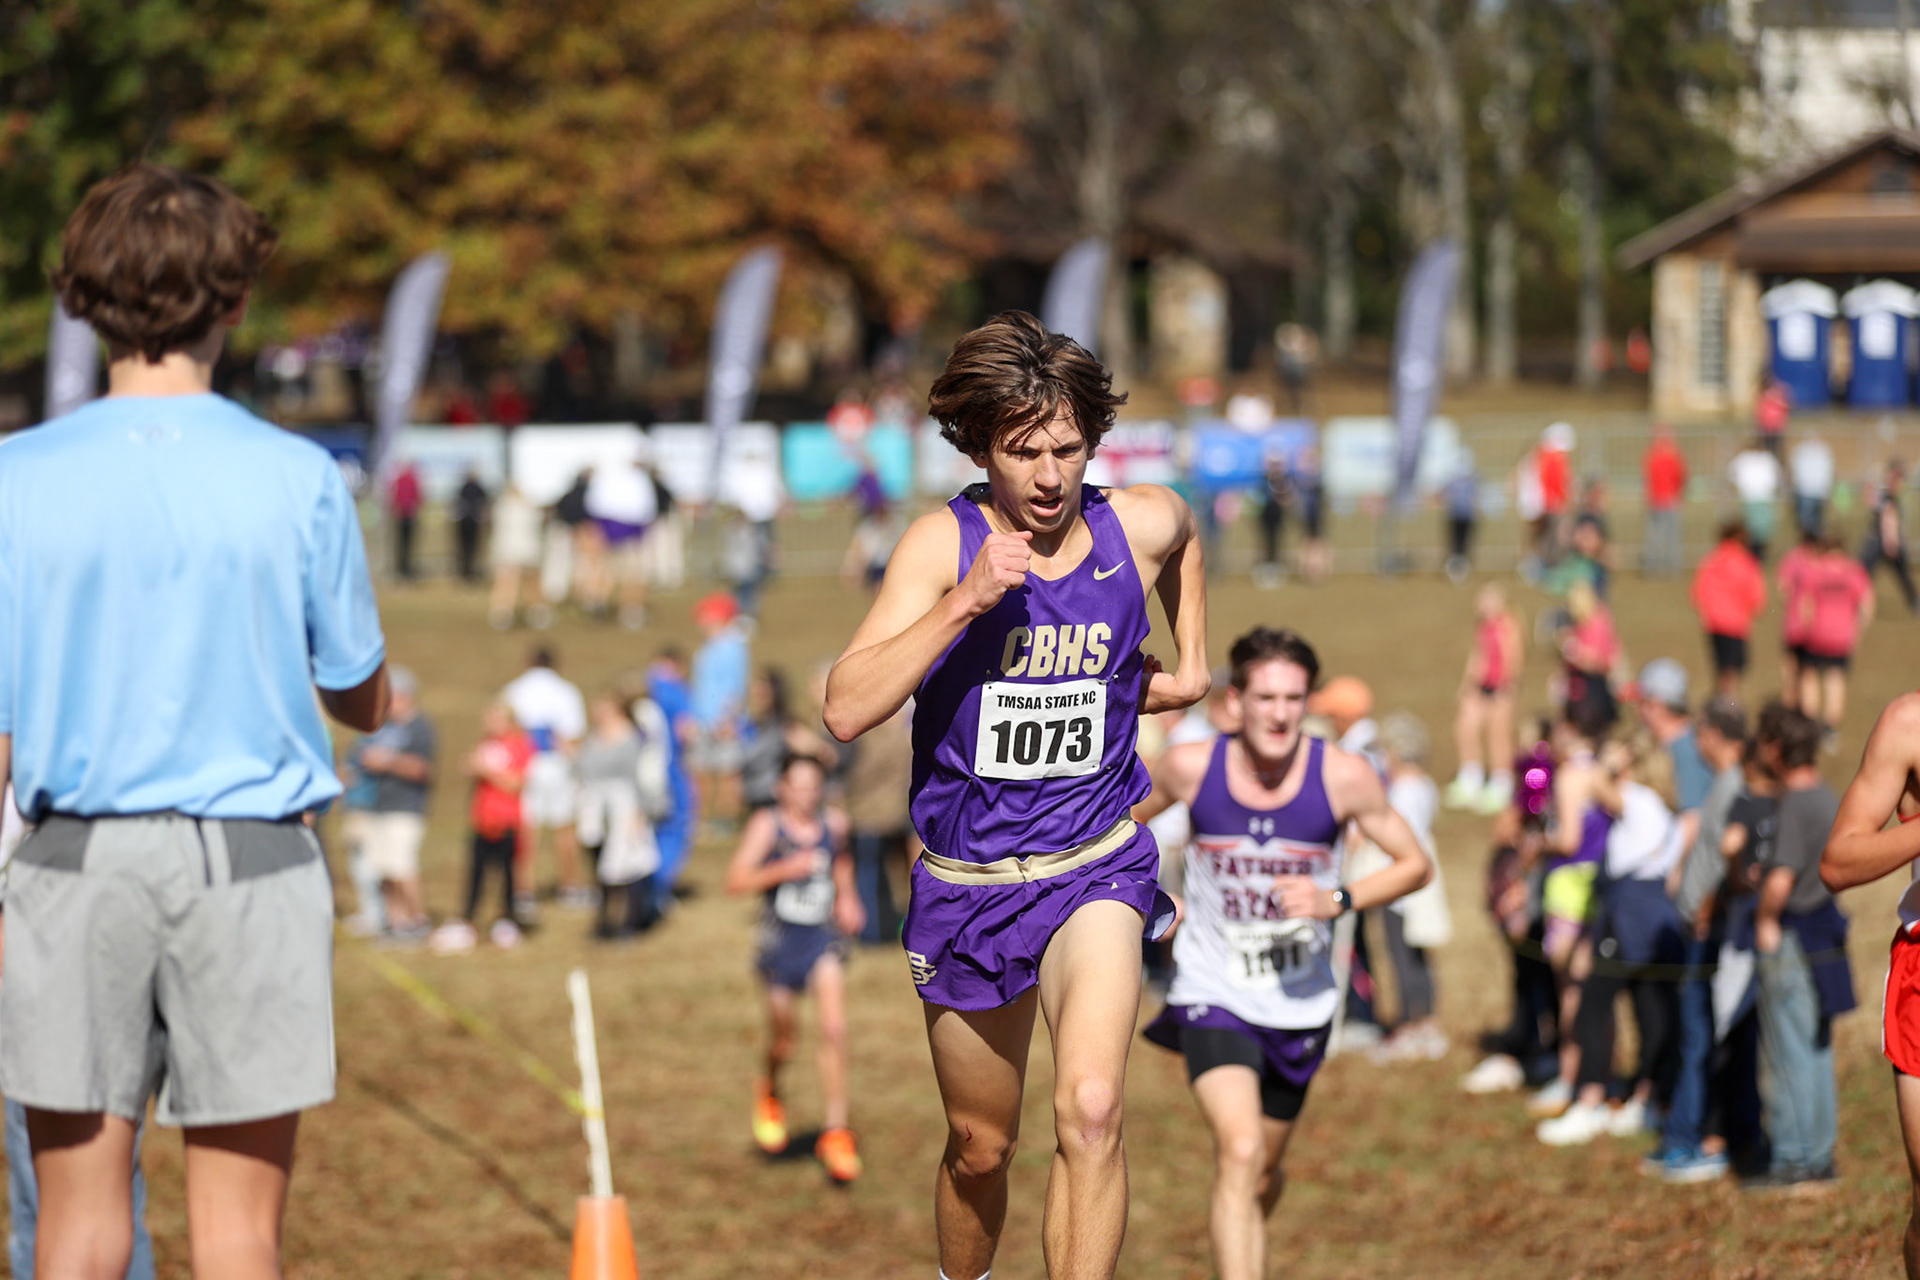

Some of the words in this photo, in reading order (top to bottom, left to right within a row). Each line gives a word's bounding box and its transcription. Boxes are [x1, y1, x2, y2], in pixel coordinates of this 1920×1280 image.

[1000, 622, 1112, 678] CBHS
[997, 694, 1041, 709] TMSAA
[1045, 693, 1079, 708] STATE
[1081, 690, 1096, 704] XC
[991, 716, 1092, 765] 1073
[1223, 886, 1287, 920] RYA
